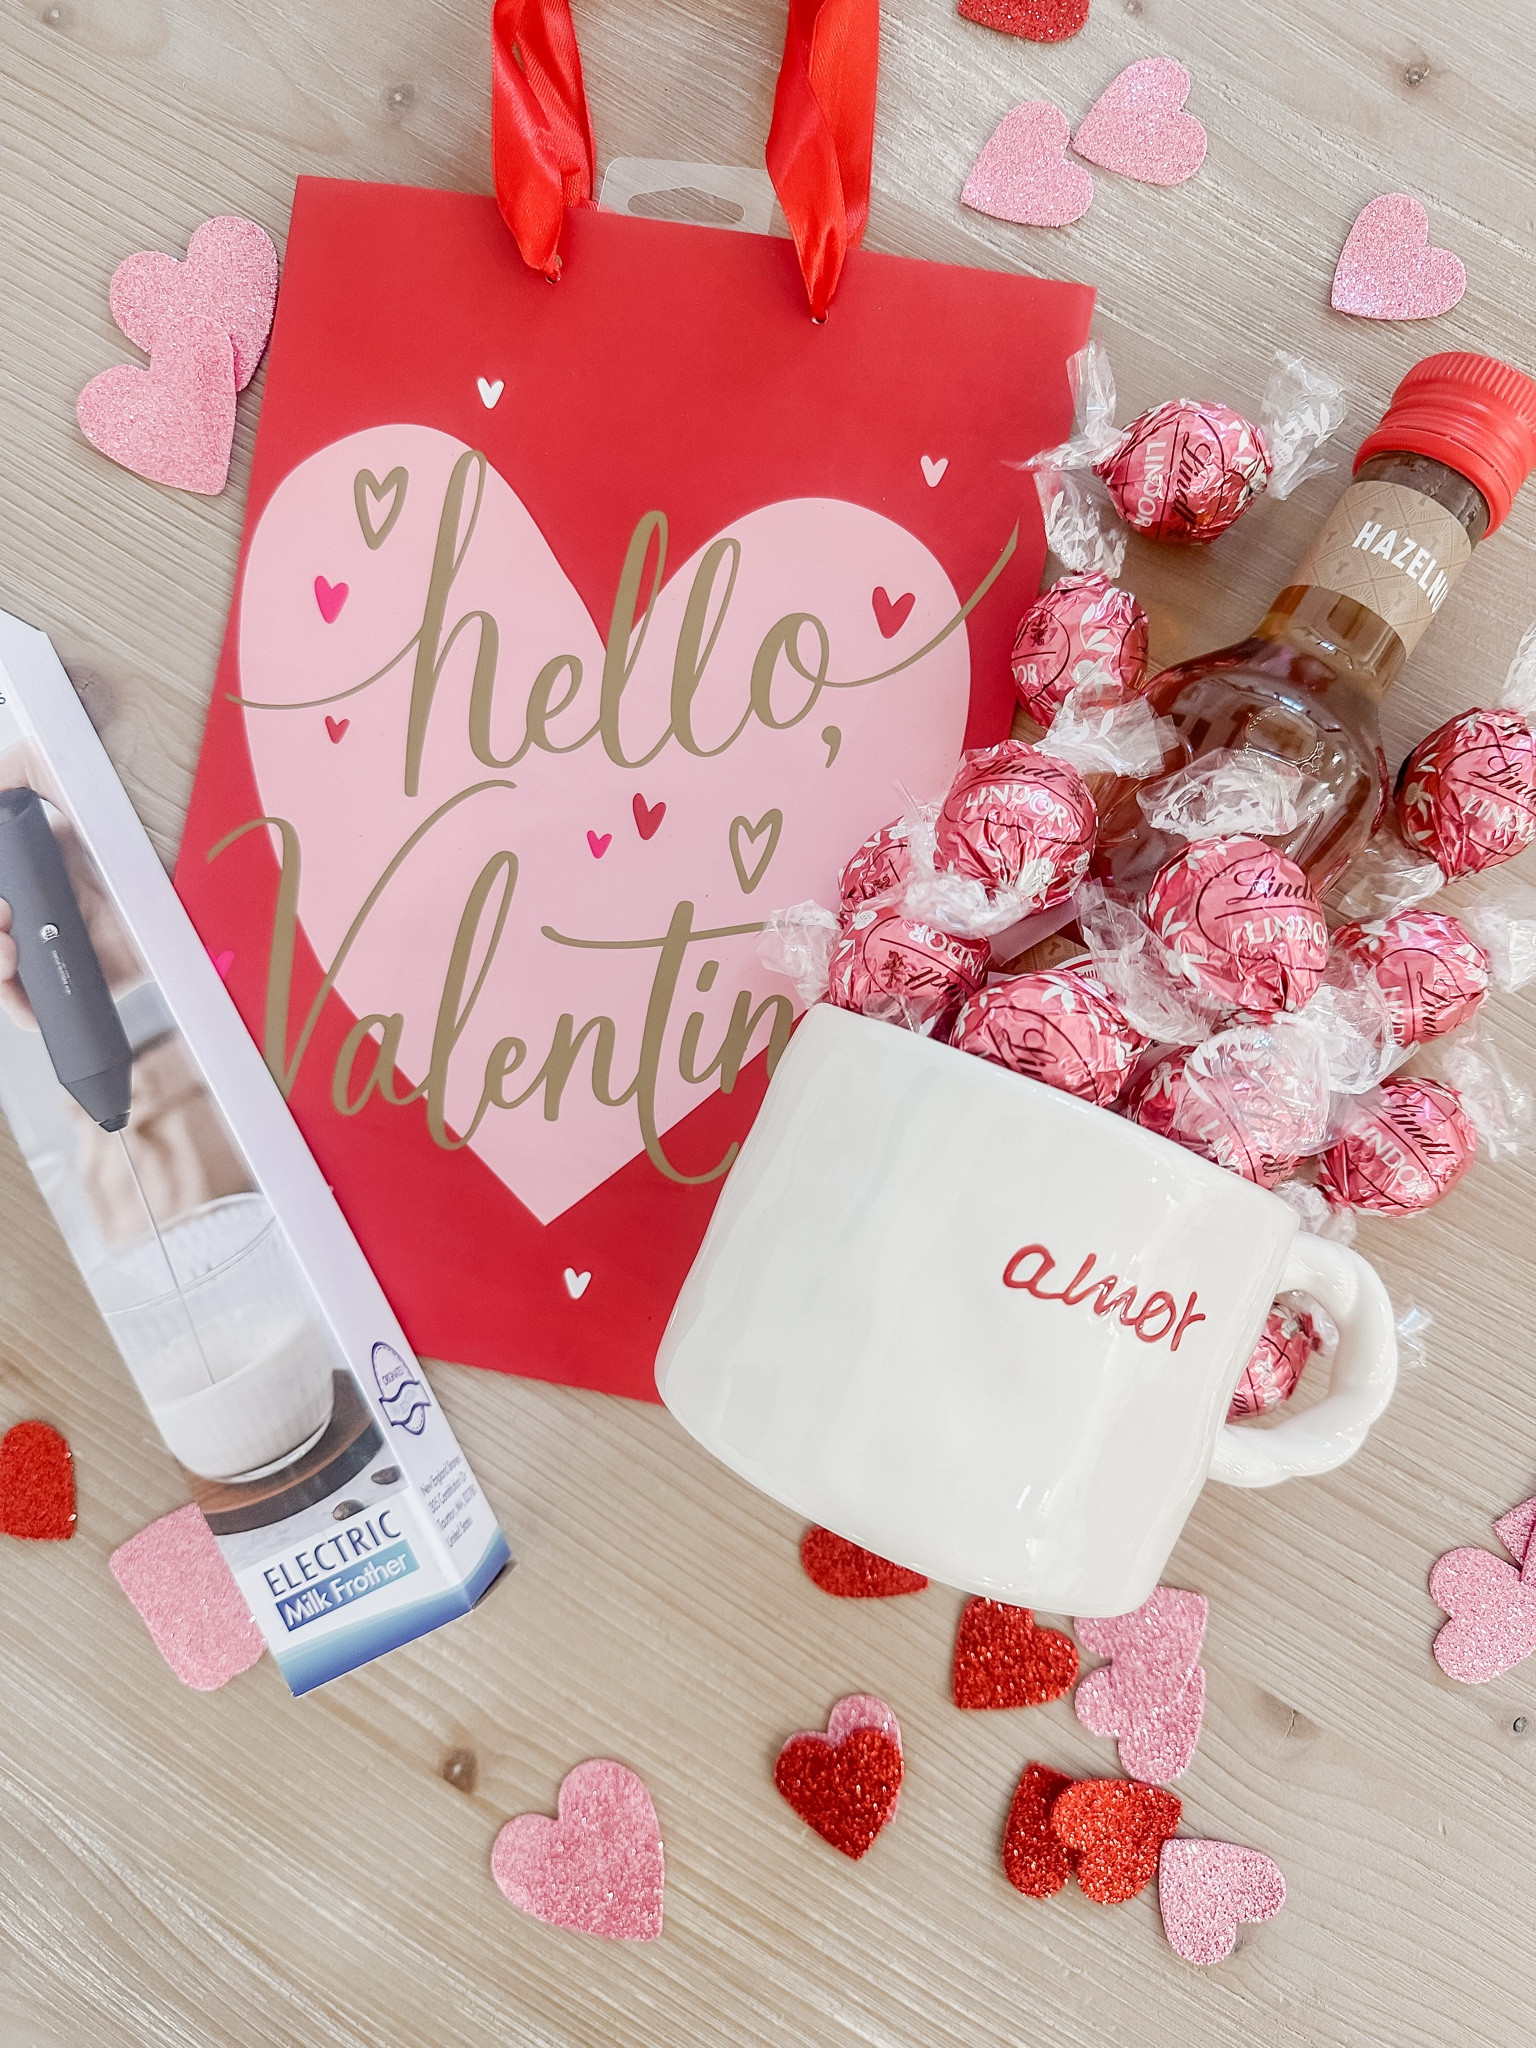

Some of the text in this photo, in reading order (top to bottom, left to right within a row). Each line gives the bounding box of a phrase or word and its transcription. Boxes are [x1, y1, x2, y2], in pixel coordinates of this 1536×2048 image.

[1134, 441, 1166, 527] LINDOR
[226, 449, 1020, 798] hello,
[965, 784, 1069, 828] LINDOR
[1002, 1242, 1206, 1352] amor
[263, 1509, 401, 1597] ELECTRIC
[284, 1552, 407, 1627] Milk Frother
